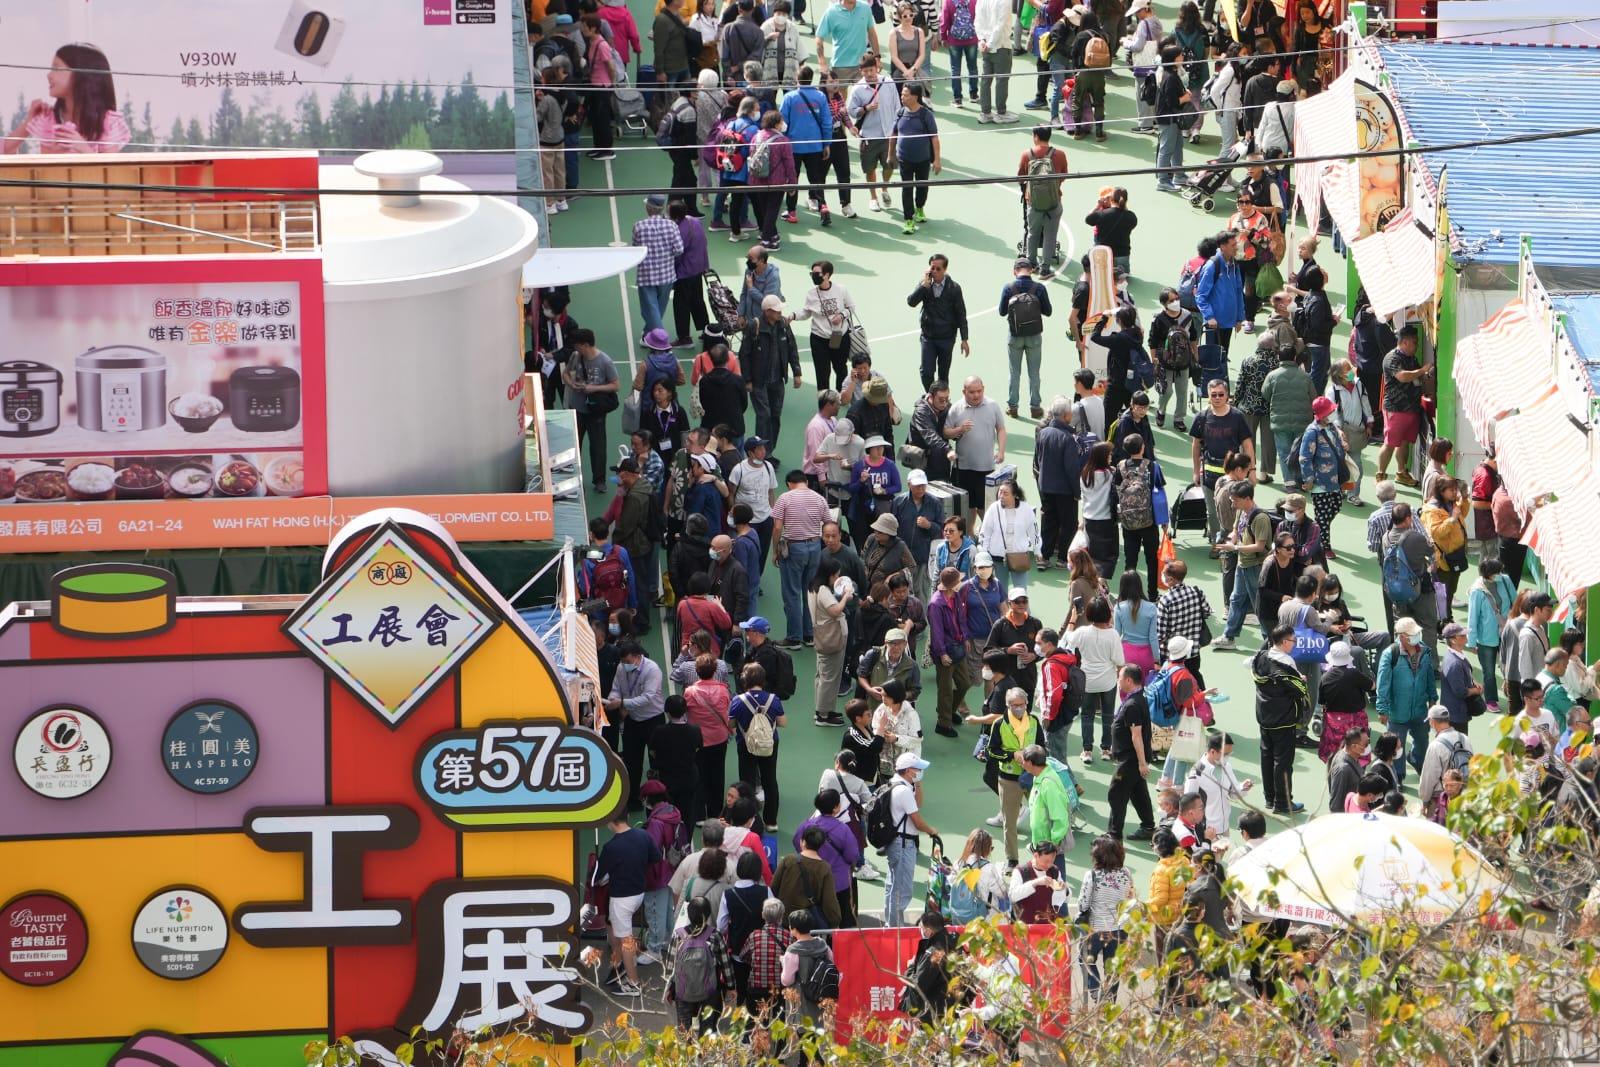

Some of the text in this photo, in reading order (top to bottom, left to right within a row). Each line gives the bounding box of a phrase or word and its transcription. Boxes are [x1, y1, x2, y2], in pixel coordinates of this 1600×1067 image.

[179, 52, 237, 66] V930W
[181, 70, 303, 88] 噴水抹窗機械人
[154, 299, 291, 318] 飯香濃郁好味道
[149, 320, 296, 343] 唯有金樂做得到
[212, 518, 243, 529] WAH
[246, 517, 271, 529] FAT
[273, 516, 311, 528] HONG
[501, 511, 522, 522] CO.
[526, 510, 551, 522] LTD.
[322, 604, 461, 649] 工展會
[171, 758, 251, 770] HASPERO
[437, 725, 588, 794] 第57屆
[10, 908, 67, 928] Gourmet
[23, 923, 64, 934] TASTY
[167, 925, 213, 934] NUTRITION
